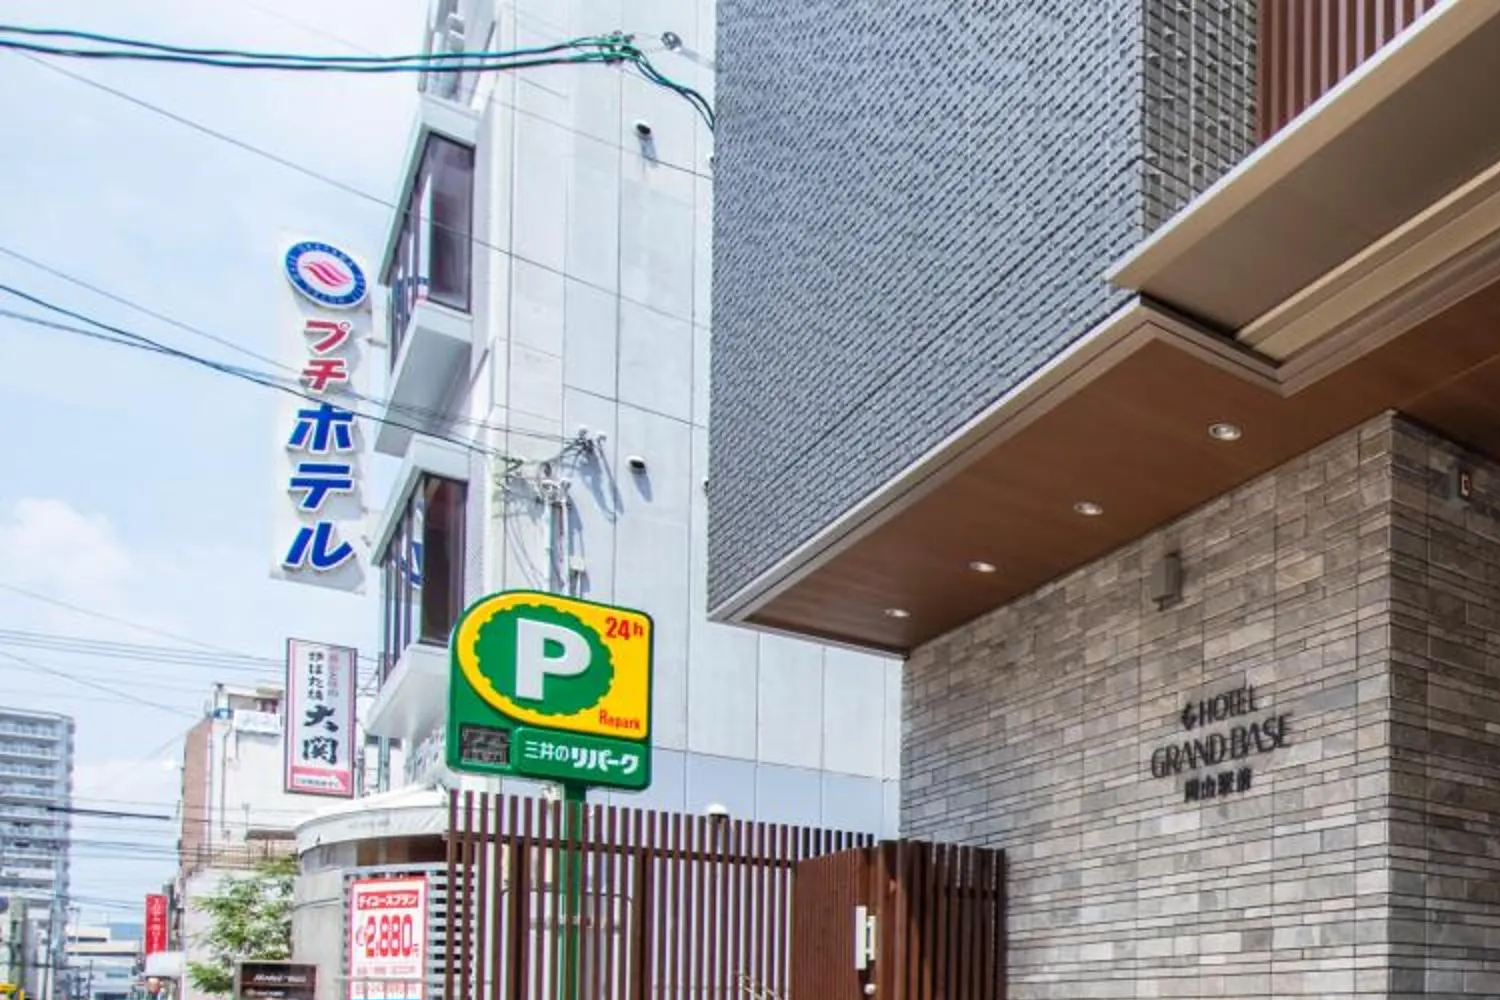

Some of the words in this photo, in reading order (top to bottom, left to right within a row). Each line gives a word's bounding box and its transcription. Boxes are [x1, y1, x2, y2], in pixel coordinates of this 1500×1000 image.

[605, 616, 643, 640] 24h
[516, 617, 592, 700] P
[599, 710, 641, 730] Repark
[1199, 684, 1258, 727] HOTEL
[523, 740, 640, 775] 三井のリパーク
[1152, 731, 1226, 778] GRAND
[1230, 711, 1293, 760] BASE
